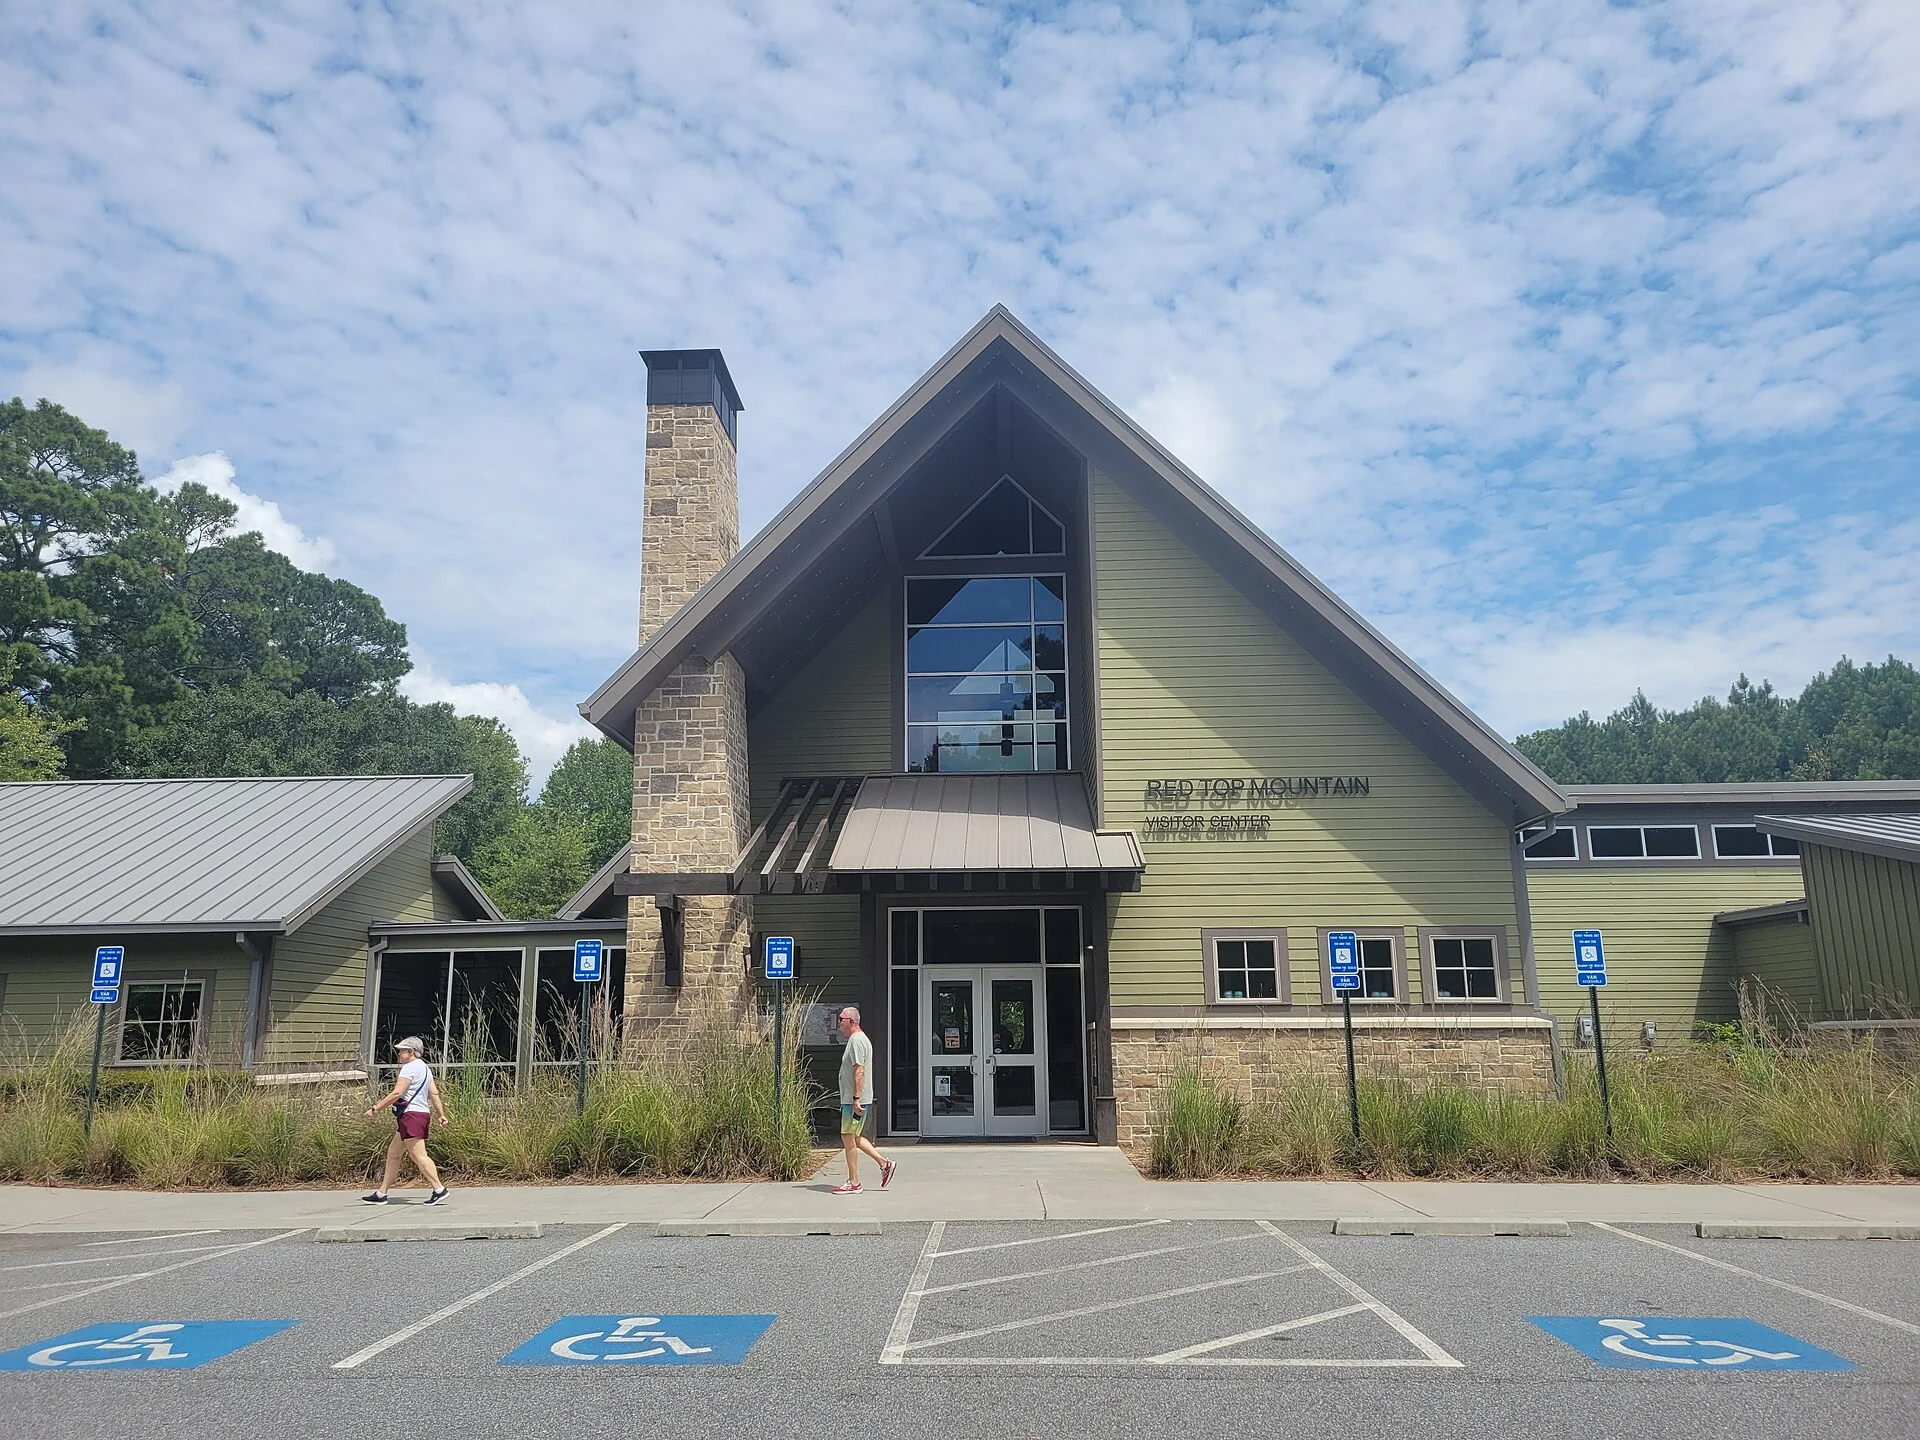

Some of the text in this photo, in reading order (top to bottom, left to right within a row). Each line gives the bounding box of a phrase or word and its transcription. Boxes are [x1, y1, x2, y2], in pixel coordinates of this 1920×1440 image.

[1147, 777, 1371, 797] RED TOP MOUNTAIN
[1145, 814, 1271, 829] VISITOR CENTER
